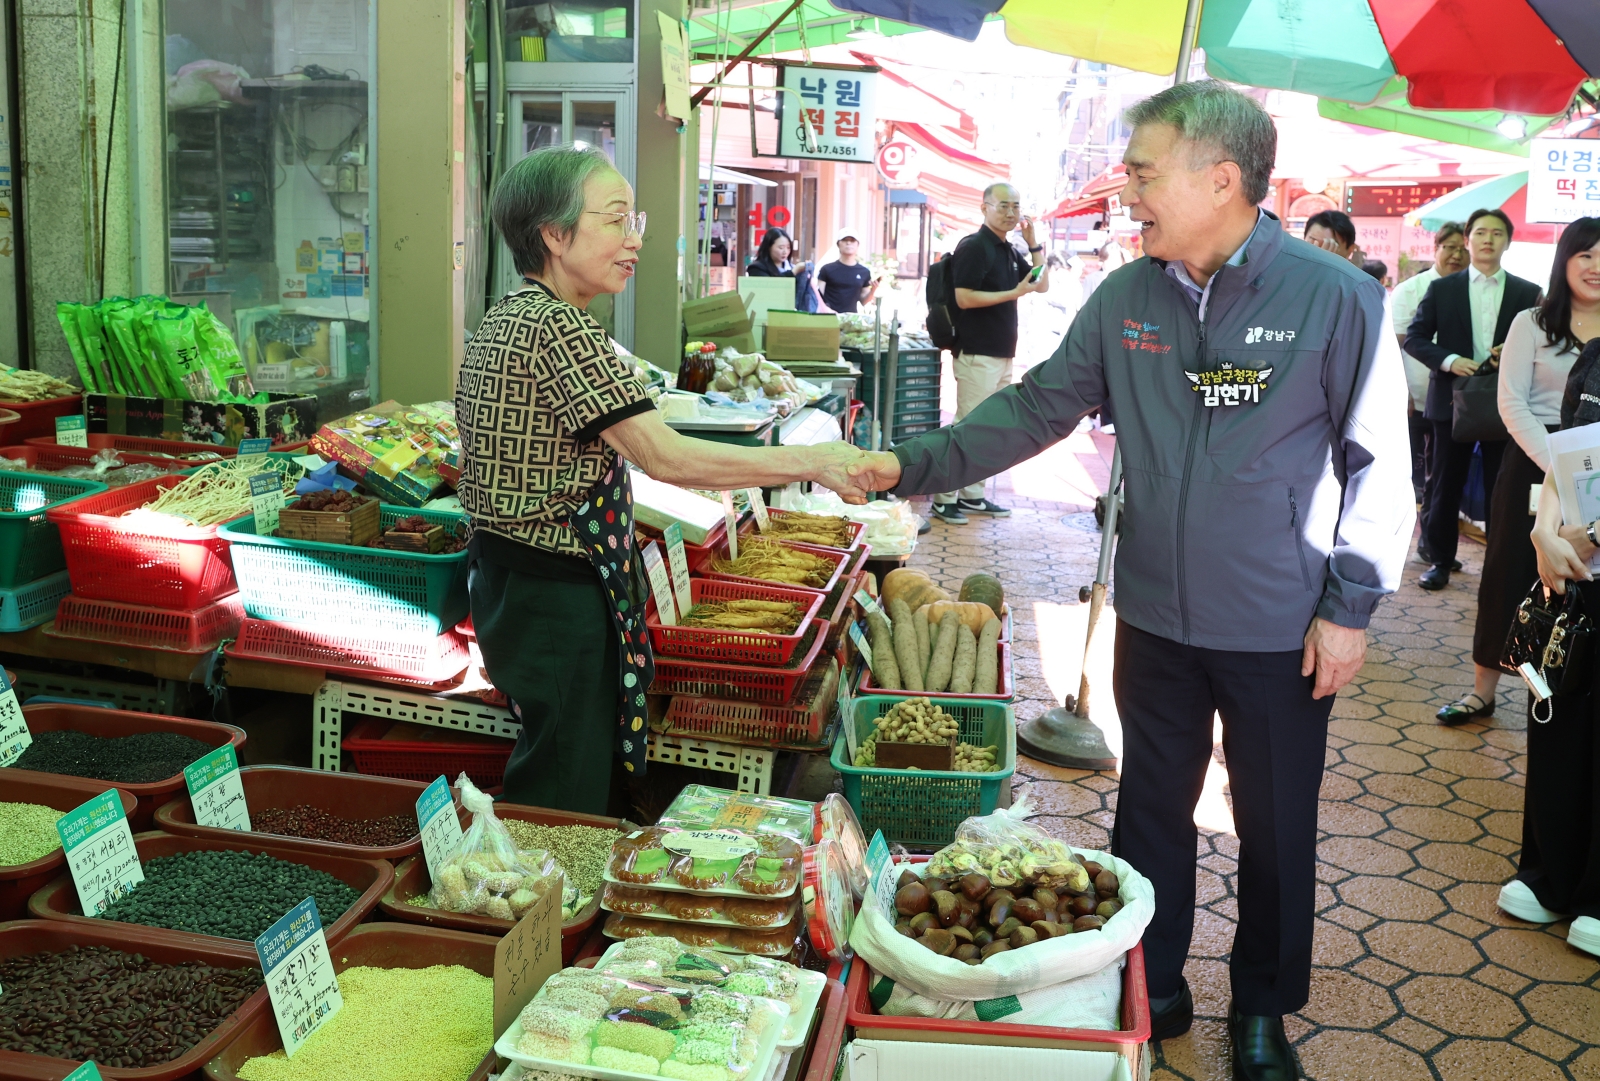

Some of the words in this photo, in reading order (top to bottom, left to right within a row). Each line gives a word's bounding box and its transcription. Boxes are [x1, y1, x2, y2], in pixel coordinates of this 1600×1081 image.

[800, 77, 861, 107] 낙원
[799, 108, 859, 138] 떡집
[1411, 227, 1435, 240] 국내
[1264, 329, 1296, 342] 강남구
[1199, 368, 1259, 385] 강남구청장
[1200, 383, 1260, 407] 김현기
[63, 815, 89, 836] 우리가게는
[90, 800, 114, 820] 원산지를
[66, 829, 85, 846] 정직하게
[85, 810, 117, 834] 표시했습니다
[263, 929, 289, 955] 우리가게는
[290, 911, 312, 932] 원산지를
[266, 945, 286, 967] 정직하게
[286, 921, 314, 949] 표시했습니다
[292, 1022, 307, 1043] SEOUL
[315, 999, 331, 1020] SOUL
